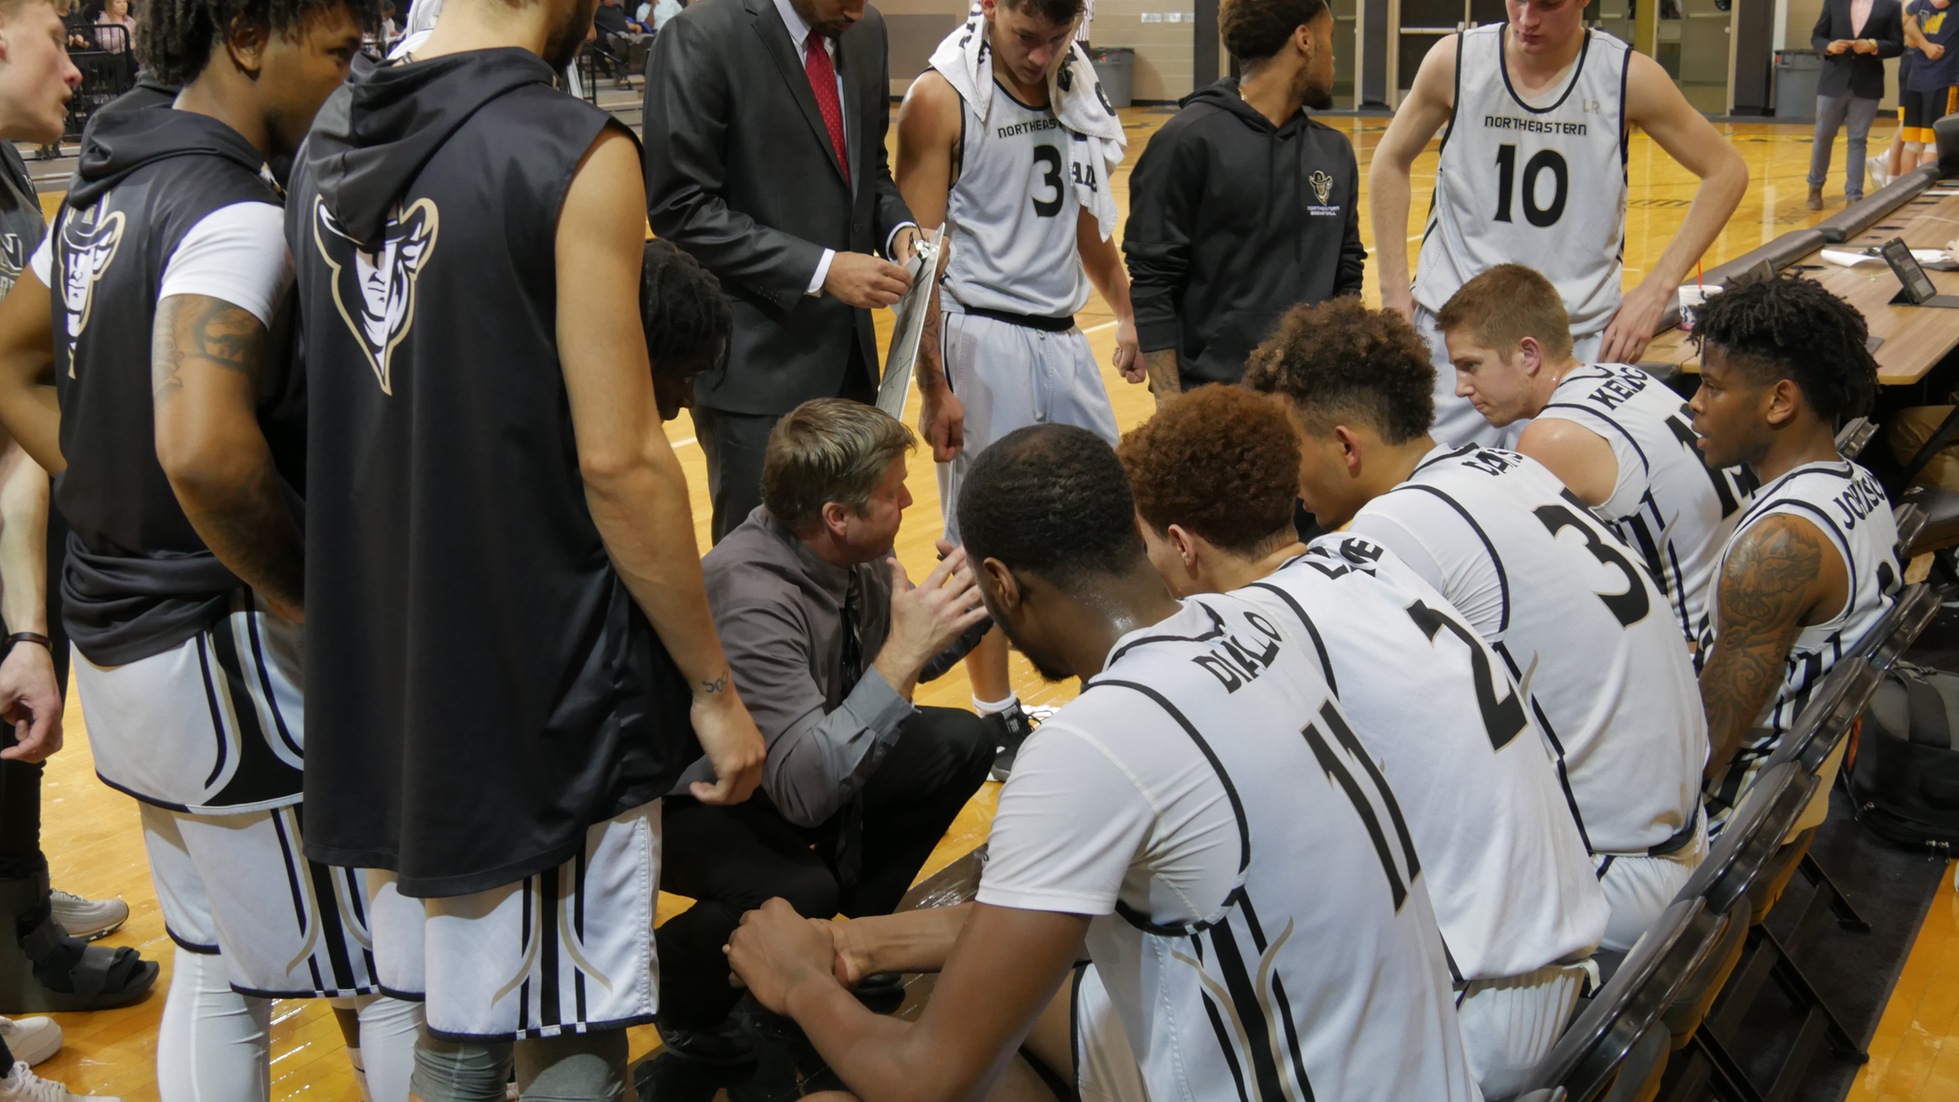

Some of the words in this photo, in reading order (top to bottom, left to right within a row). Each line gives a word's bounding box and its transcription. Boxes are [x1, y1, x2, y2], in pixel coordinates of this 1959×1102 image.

[1484, 116, 1587, 136] NORTHEASTERN
[1582, 98, 1600, 115] LR
[1030, 144, 1064, 218] 3
[1492, 143, 1569, 228] 10
[1404, 597, 1530, 755] 2
[1299, 696, 1422, 918] 11
